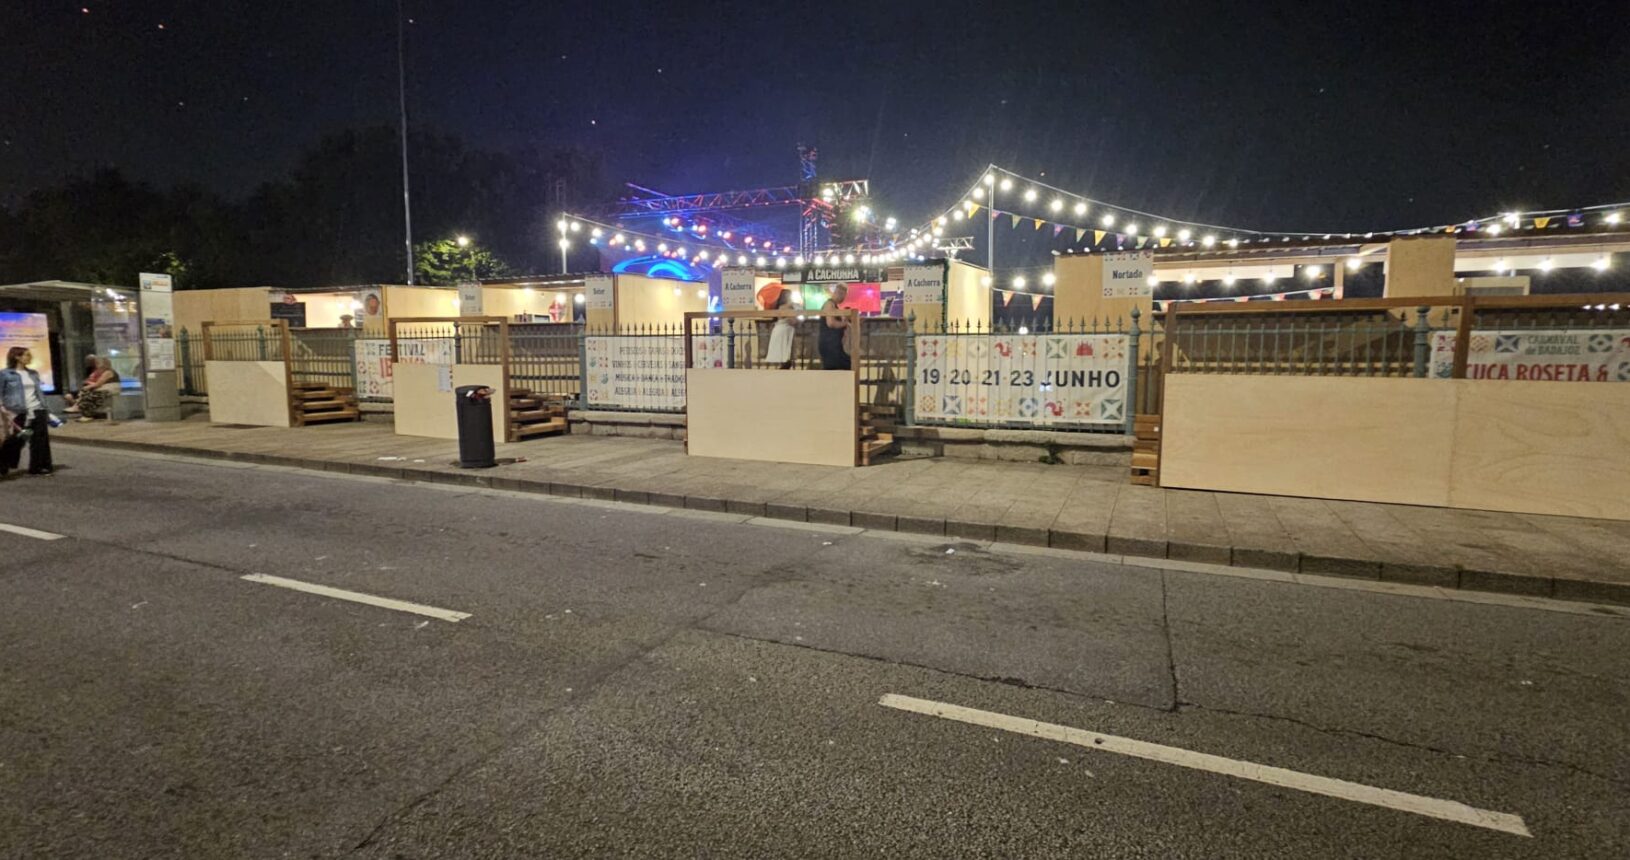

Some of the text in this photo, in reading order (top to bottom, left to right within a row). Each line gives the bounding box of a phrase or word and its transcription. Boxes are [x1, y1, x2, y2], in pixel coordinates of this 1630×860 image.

[807, 269, 859, 280] A CACHORRA
[725, 282, 752, 290] A Cachorra
[907, 279, 941, 287] A Cachorra
[378, 343, 425, 356] FETIVAL
[1516, 363, 1590, 381] ROSETA
[922, 369, 1121, 388] 19 20 21 23 JUNHO
